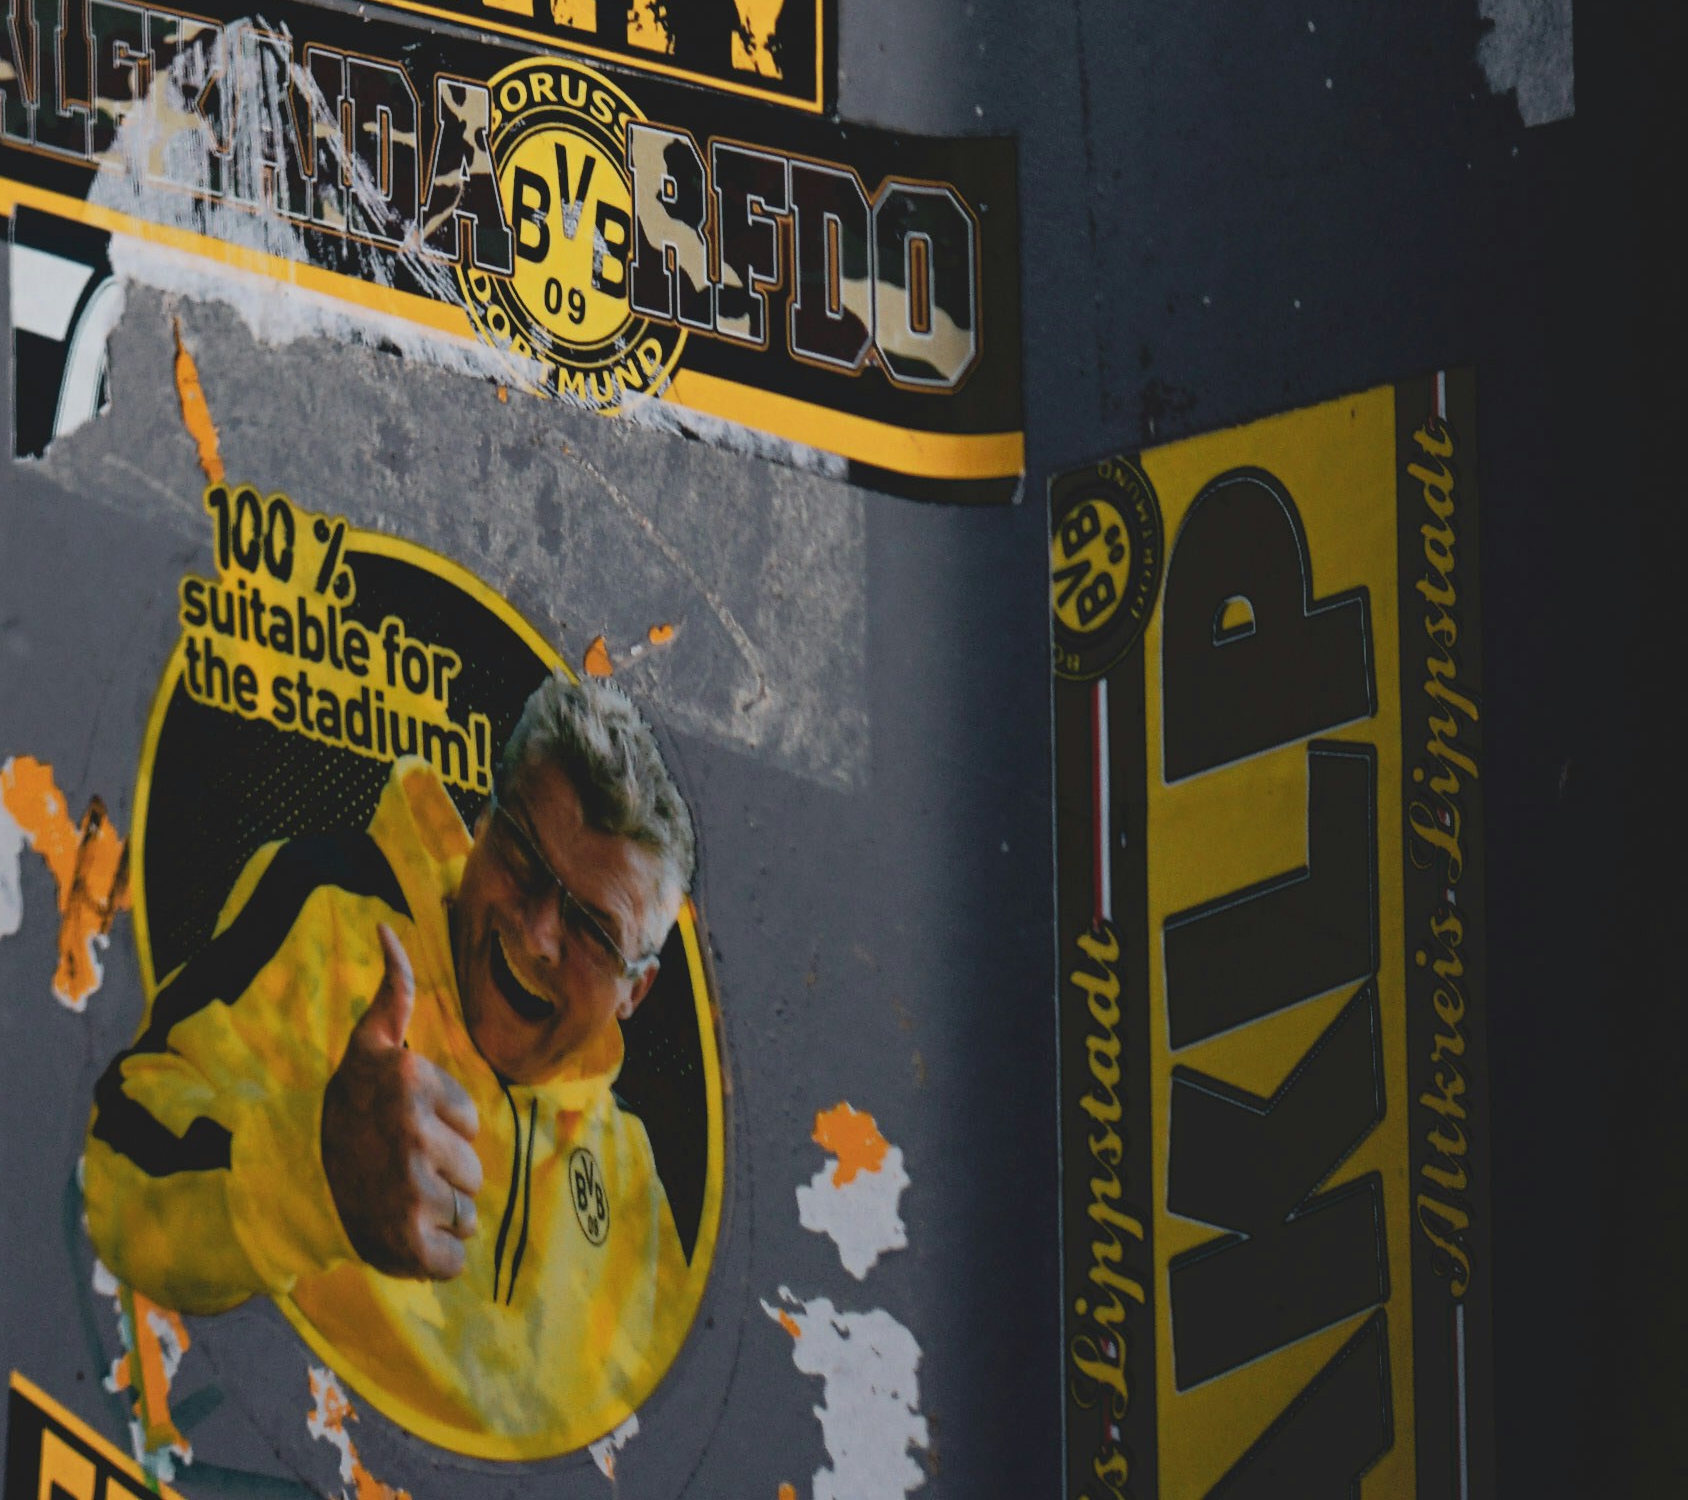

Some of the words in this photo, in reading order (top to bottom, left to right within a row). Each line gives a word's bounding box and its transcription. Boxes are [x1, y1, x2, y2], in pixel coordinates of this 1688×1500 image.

[513, 143, 631, 299] BVB
[544, 276, 587, 325] 09
[208, 486, 296, 582] 100
[313, 518, 351, 600] %
[184, 579, 370, 677] suitable
[382, 622, 457, 702] for
[186, 636, 259, 712] the
[271, 670, 488, 788] stadium!
[1410, 414, 1481, 883] Lippstadt
[1069, 921, 1146, 1420] Lippstadt
[1413, 909, 1471, 1299] Altkreis
[575, 1155, 605, 1220] BVB
